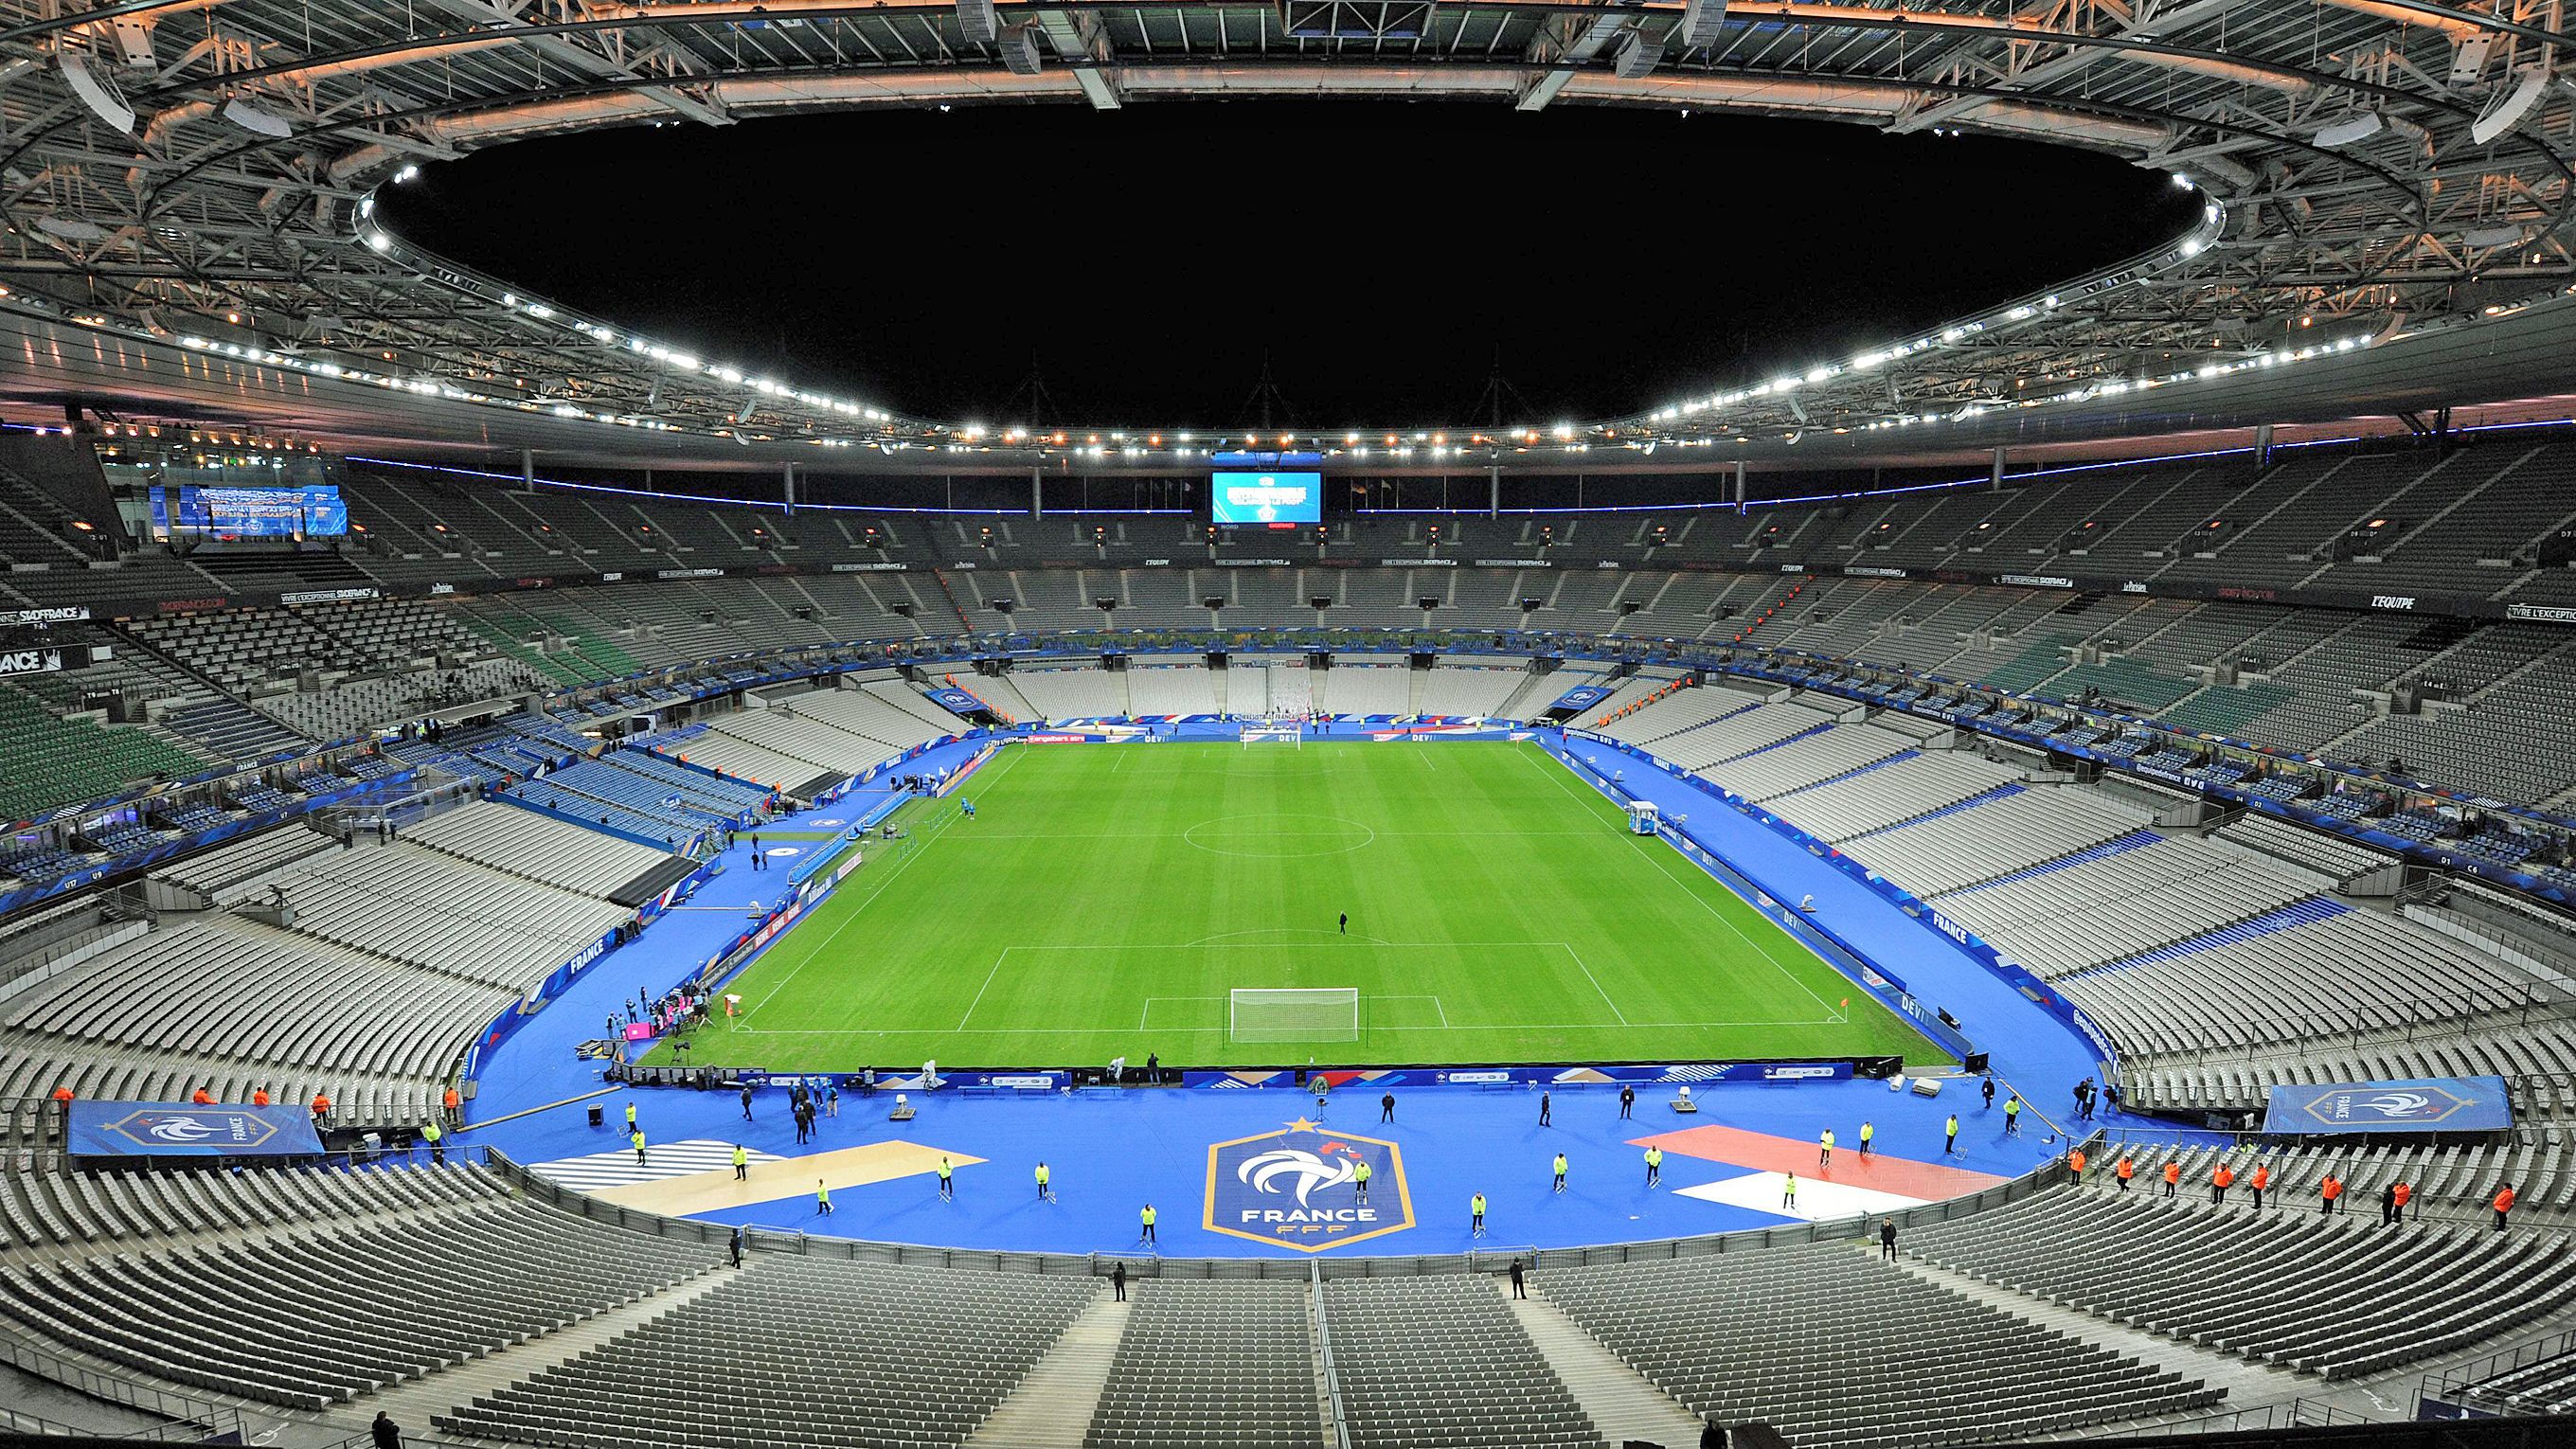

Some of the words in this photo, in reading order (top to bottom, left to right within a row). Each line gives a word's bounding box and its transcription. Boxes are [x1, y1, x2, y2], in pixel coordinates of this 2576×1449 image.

[237, 760, 259, 772] FRANCE
[1933, 912, 1967, 944] FRANCE
[570, 939, 604, 974] FRANCE
[2335, 1095, 2351, 1119] FRANCE
[228, 1117, 248, 1141] FRANCE
[1241, 1208, 1378, 1224] FRANCE
[1276, 1225, 1349, 1235] FFF
